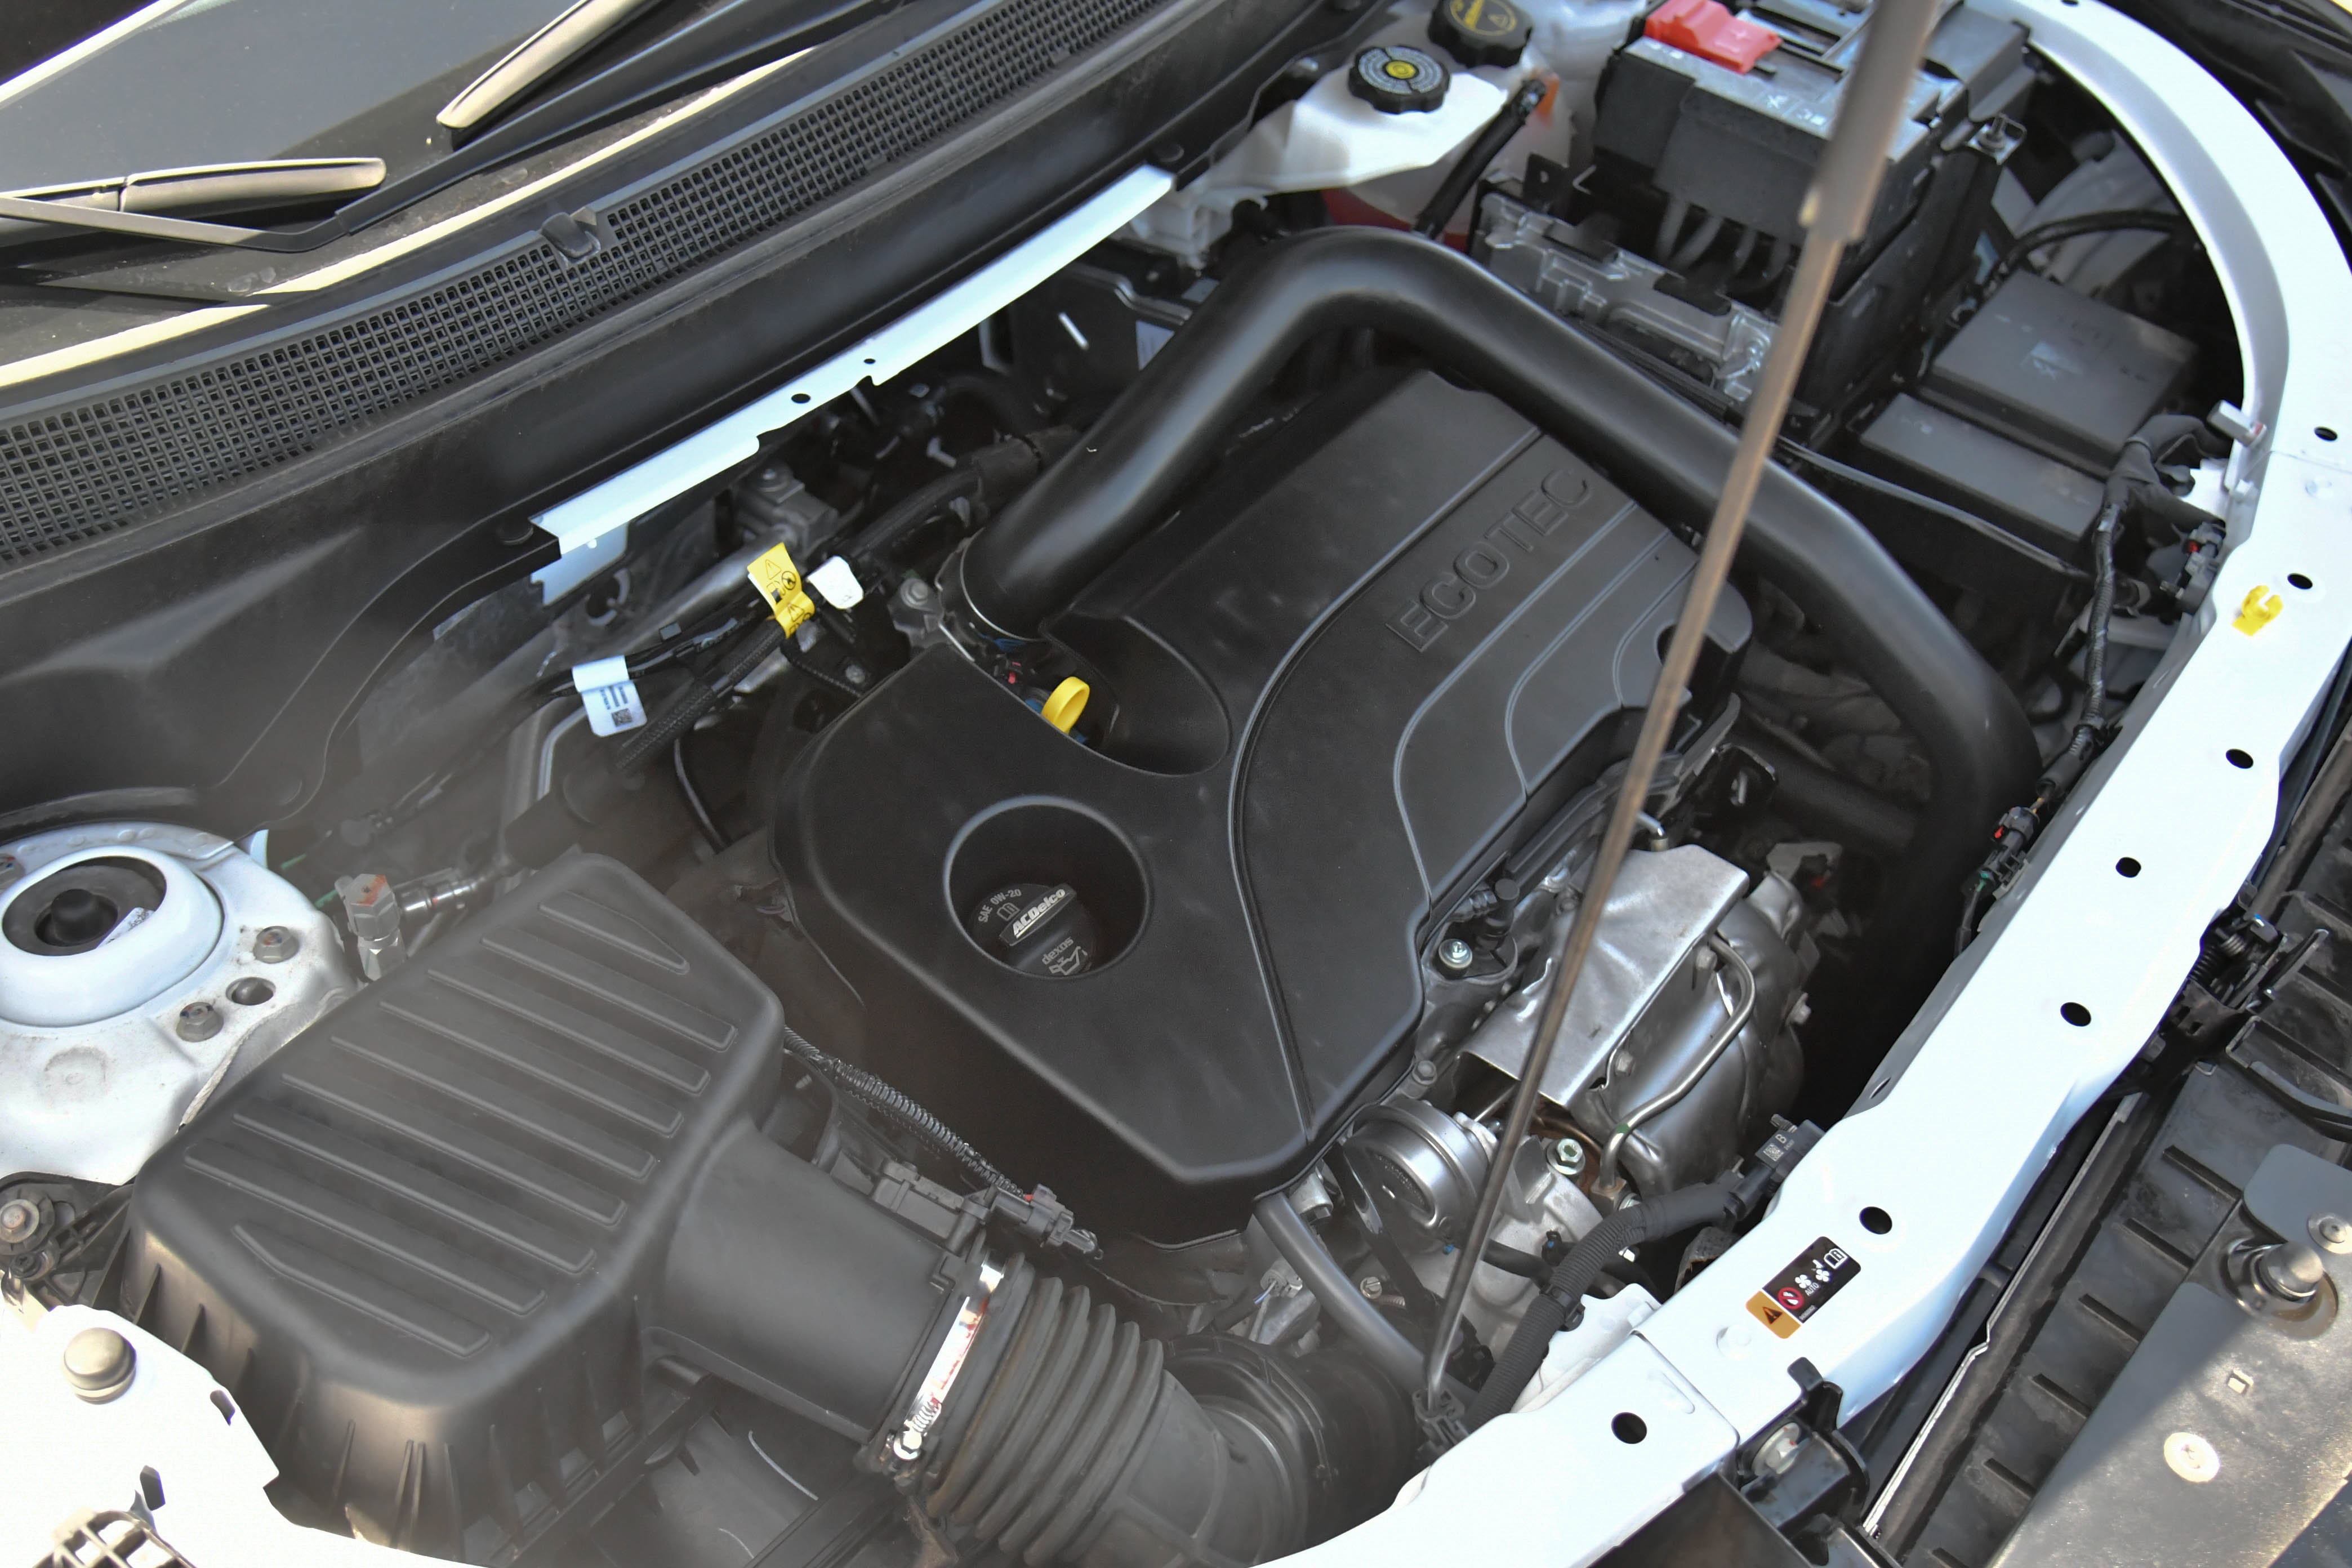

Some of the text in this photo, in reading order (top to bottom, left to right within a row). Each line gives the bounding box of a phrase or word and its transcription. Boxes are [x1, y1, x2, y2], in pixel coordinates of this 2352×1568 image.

[1384, 467, 1591, 653] ECOTEC
[978, 889, 1022, 923] SAE 0W-20
[1012, 889, 1066, 936] ACDelco
[1042, 937, 1074, 965] dexos
[1775, 1134, 1787, 1144] B
[1805, 1282, 1819, 1297] AUTO
